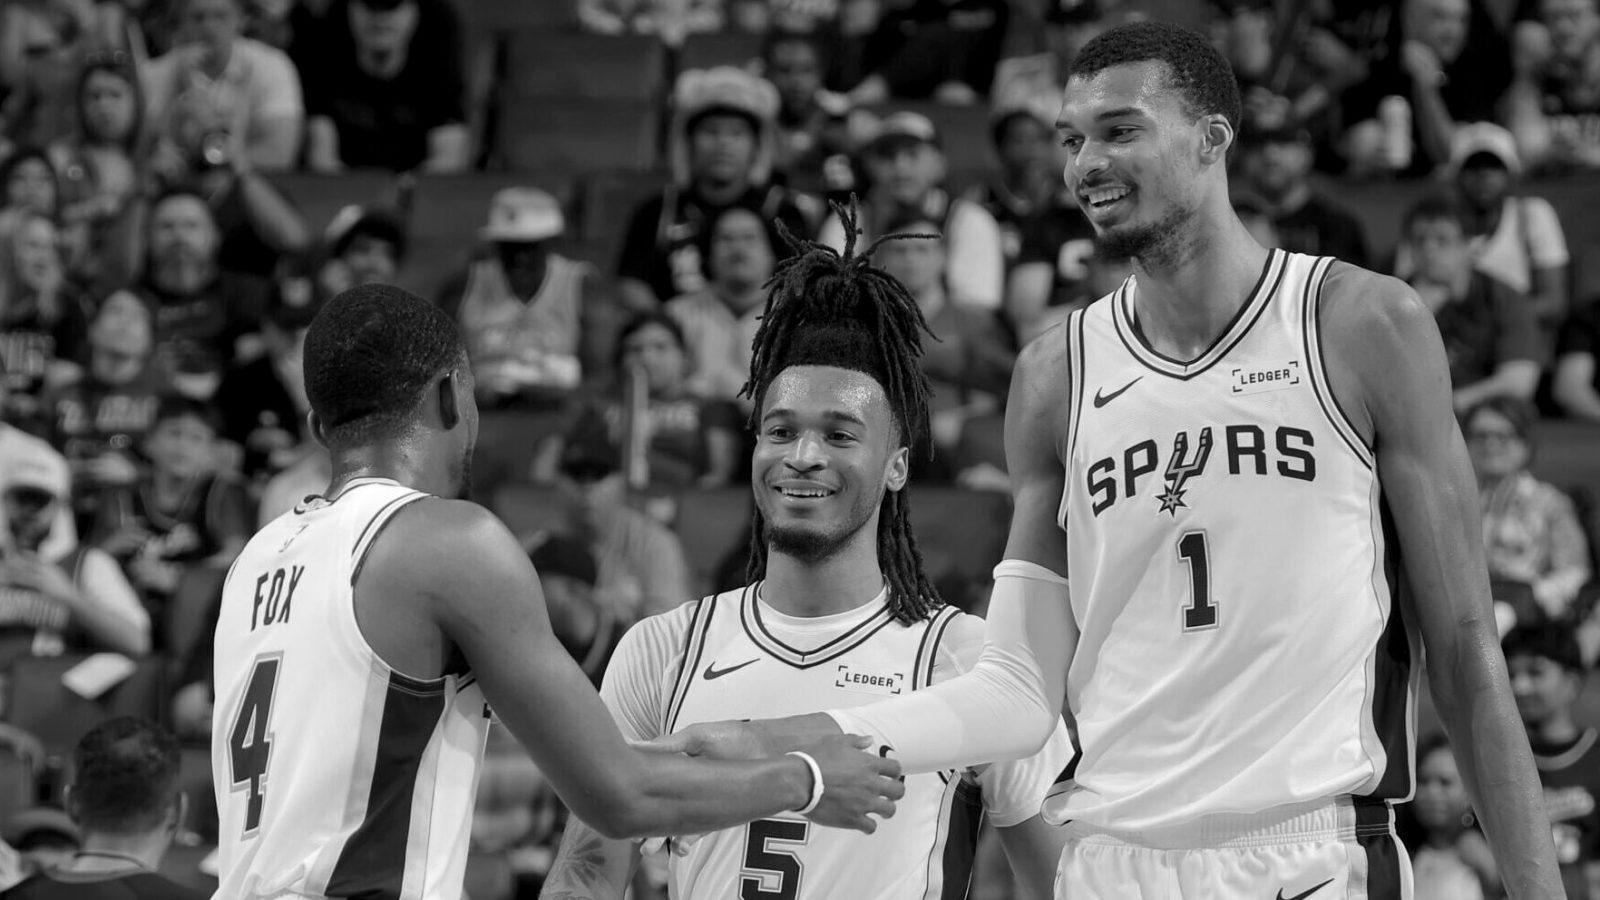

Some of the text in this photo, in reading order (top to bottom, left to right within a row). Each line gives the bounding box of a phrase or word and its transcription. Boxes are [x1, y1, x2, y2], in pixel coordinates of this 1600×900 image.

[1240, 369, 1291, 385] LEDGER
[1087, 425, 1315, 517] SPURS
[250, 565, 305, 631] FOX
[1177, 530, 1219, 631] 1
[845, 672, 894, 688] LEDGER
[228, 651, 284, 840] 4
[738, 818, 811, 900] 5
